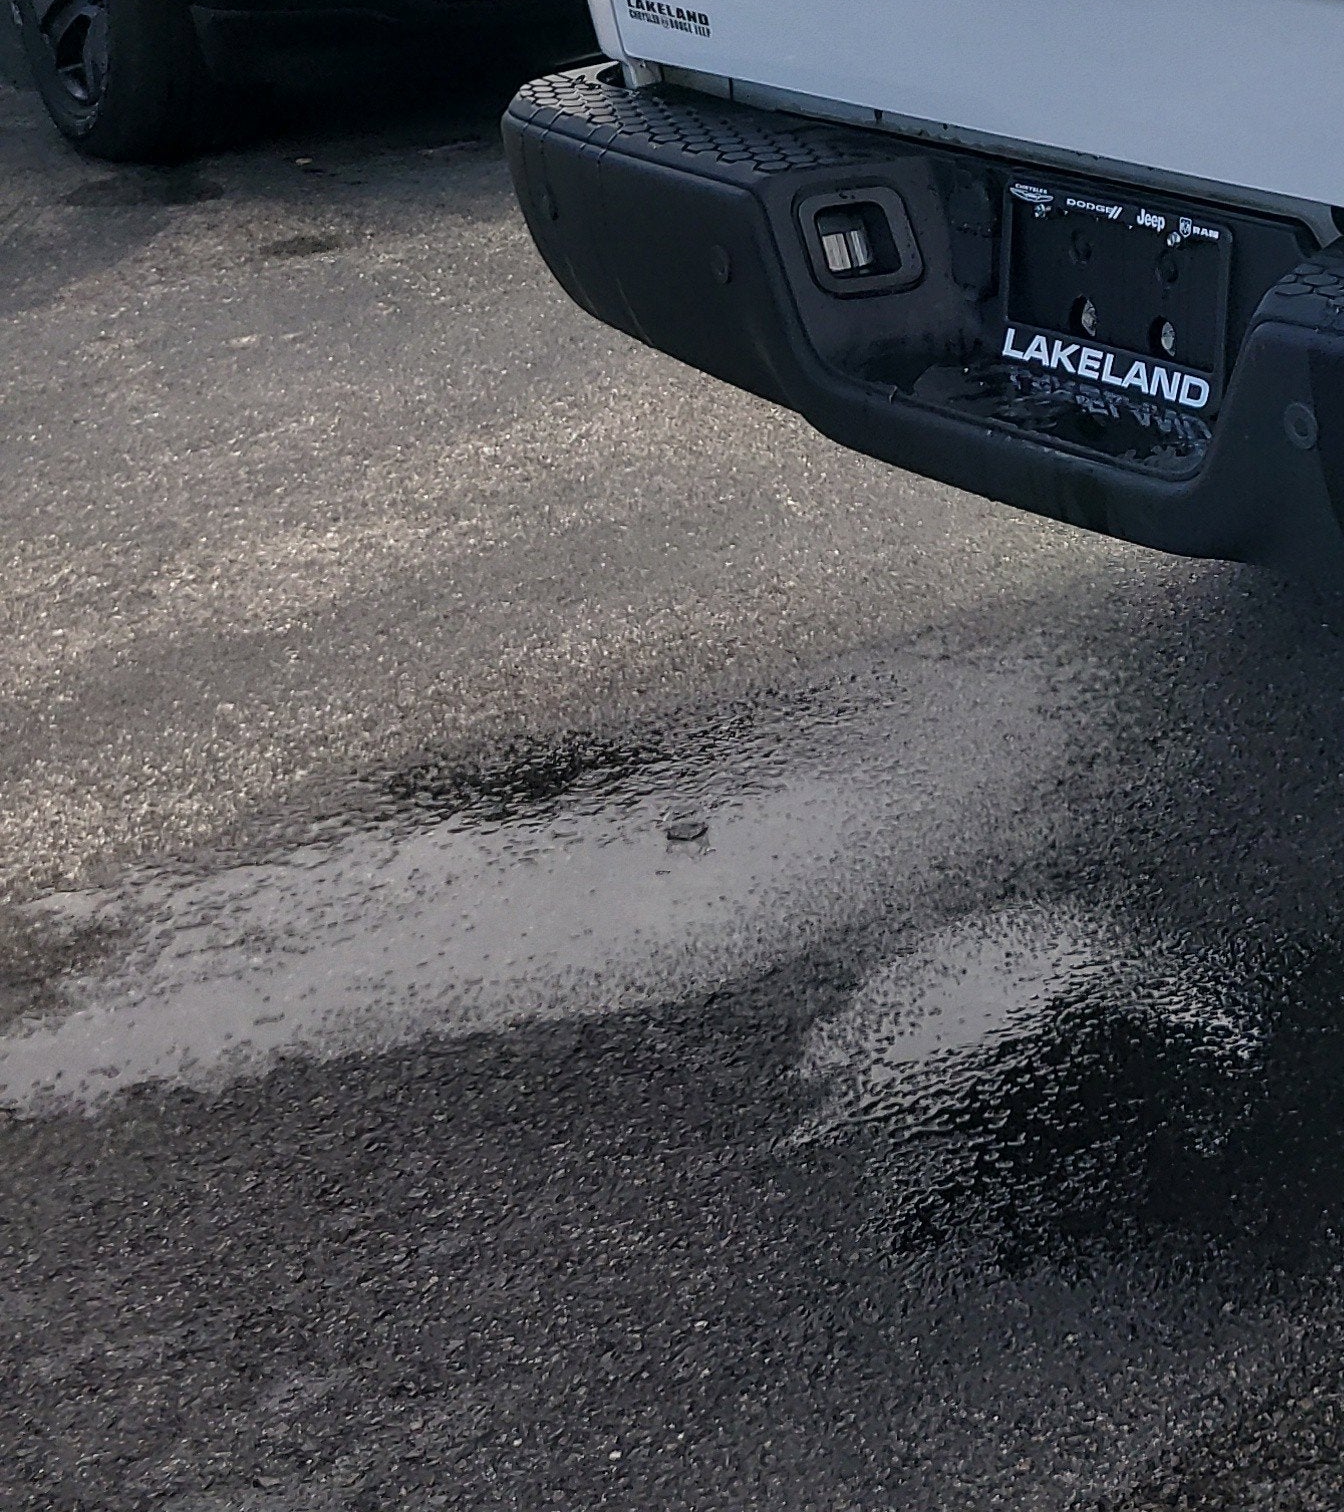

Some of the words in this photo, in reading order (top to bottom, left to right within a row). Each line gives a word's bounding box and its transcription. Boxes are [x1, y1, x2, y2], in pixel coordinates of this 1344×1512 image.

[1137, 208, 1166, 233] Jeep
[1192, 225, 1219, 239] RAM
[1002, 327, 1210, 408] LAKELAND
